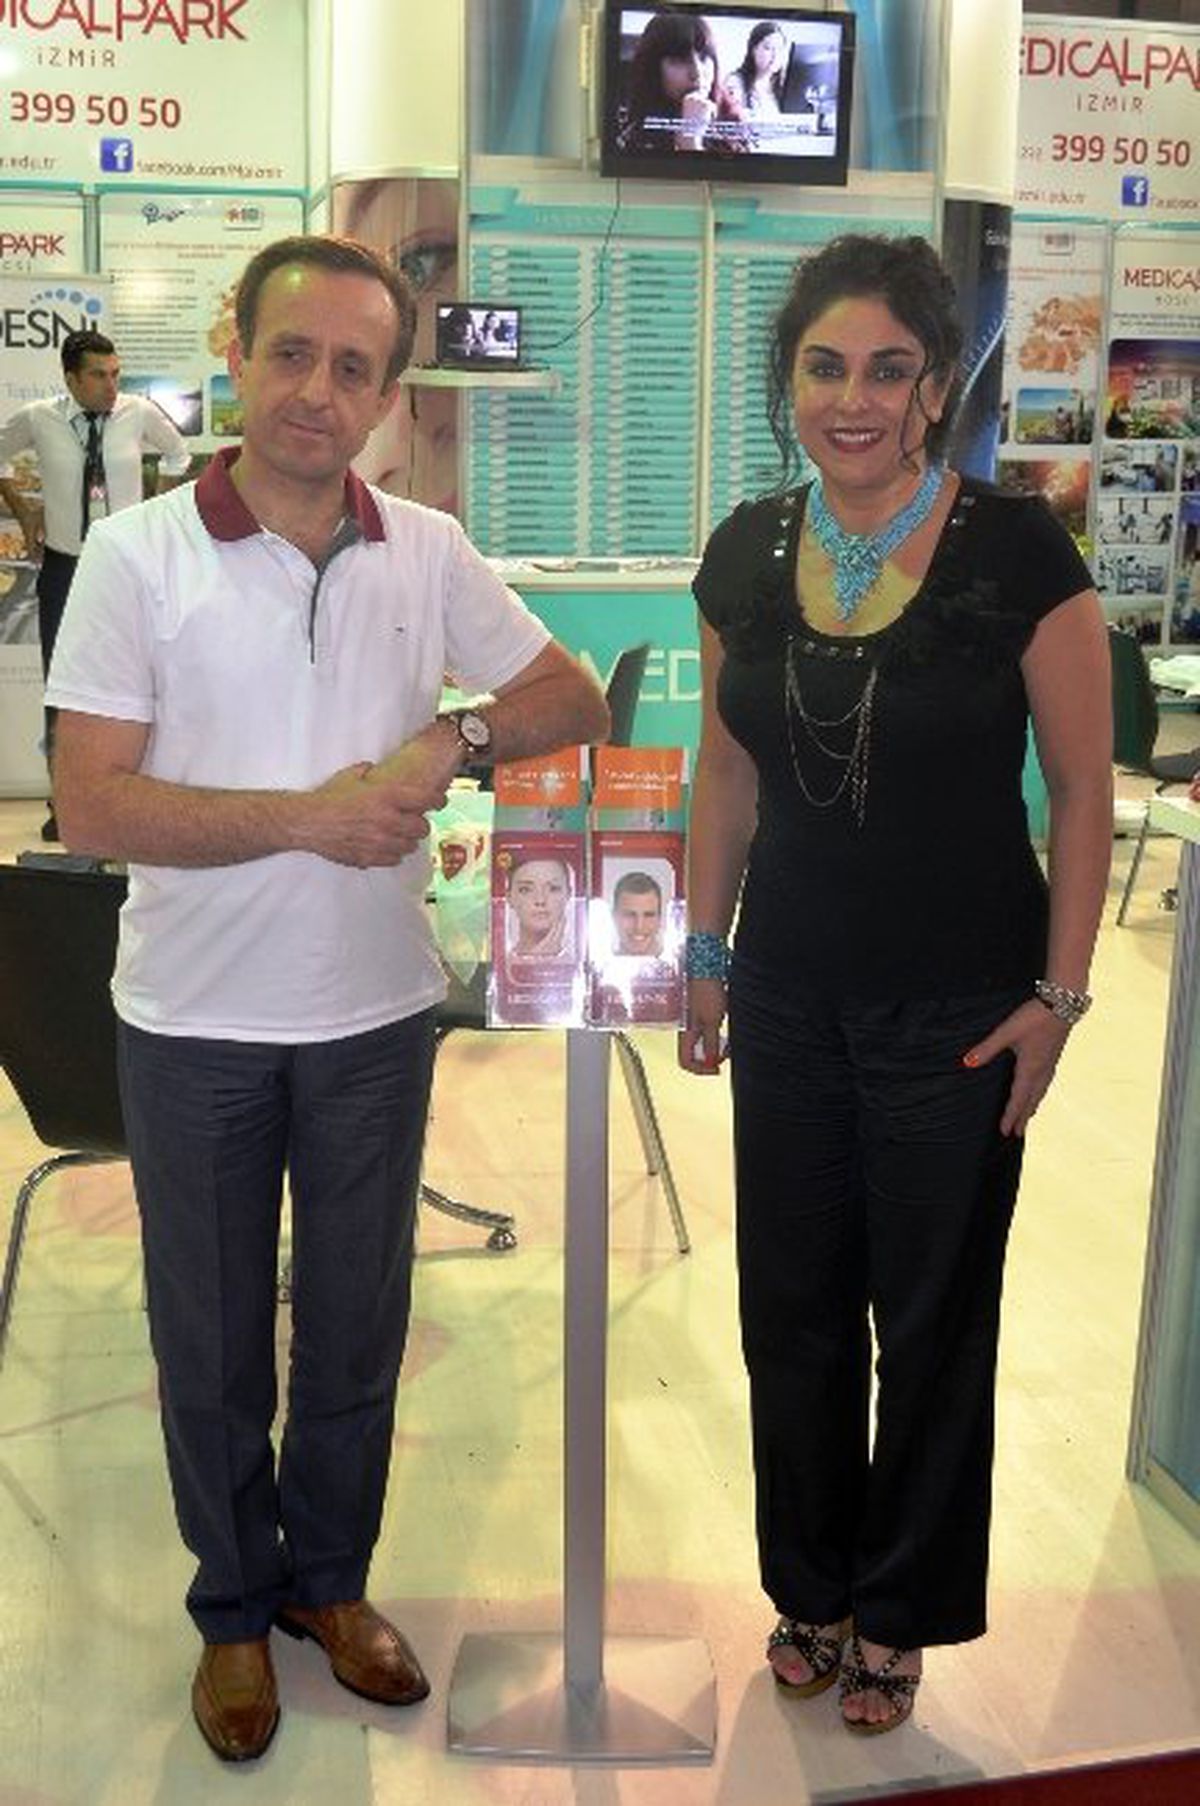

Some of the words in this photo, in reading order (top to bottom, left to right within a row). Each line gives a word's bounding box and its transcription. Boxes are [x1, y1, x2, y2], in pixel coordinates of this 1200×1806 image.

[0, 0, 248, 44] ICALPARK
[1019, 36, 1200, 92] DICALPA
[10, 91, 75, 123] 399
[86, 95, 128, 125] 50
[138, 98, 181, 128] 50
[1052, 134, 1104, 162] 399
[1113, 137, 1148, 165] 50
[1156, 140, 1191, 167] 50
[1124, 267, 1200, 293] MEDICA
[0, 309, 98, 349] ESN
